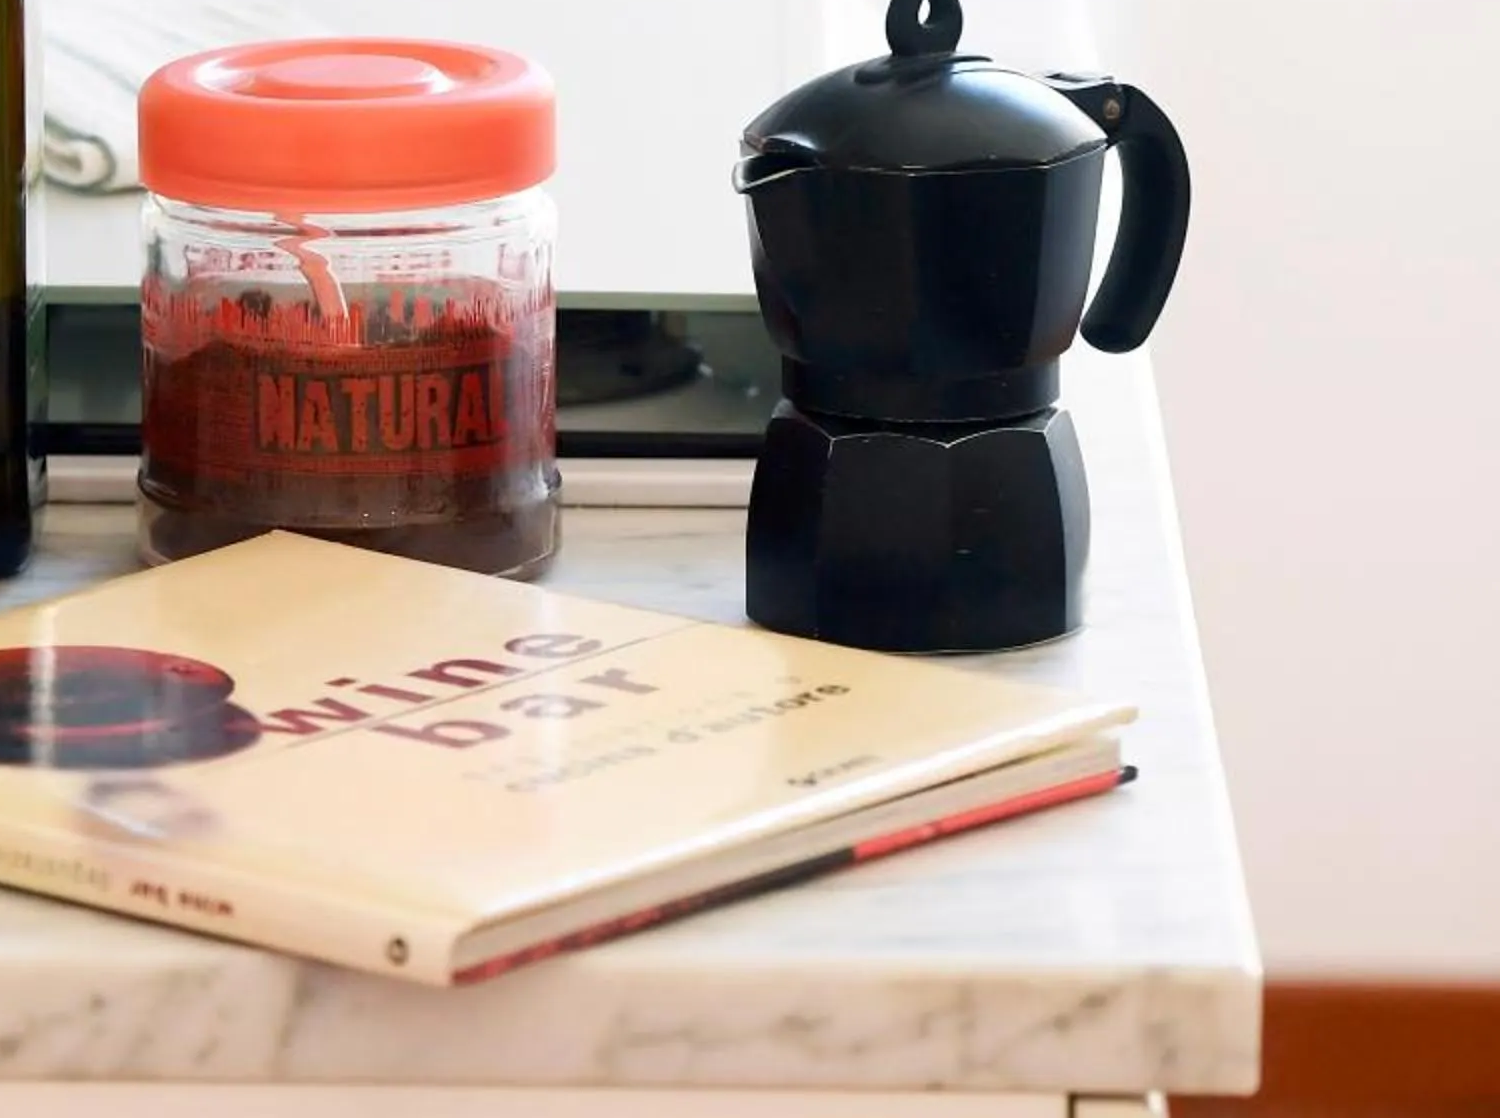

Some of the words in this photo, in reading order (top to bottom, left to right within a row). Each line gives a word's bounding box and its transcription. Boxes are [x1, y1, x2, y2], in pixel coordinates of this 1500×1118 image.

[257, 367, 510, 454] NATURAL
[257, 633, 603, 736] wine
[371, 667, 660, 749] bar
